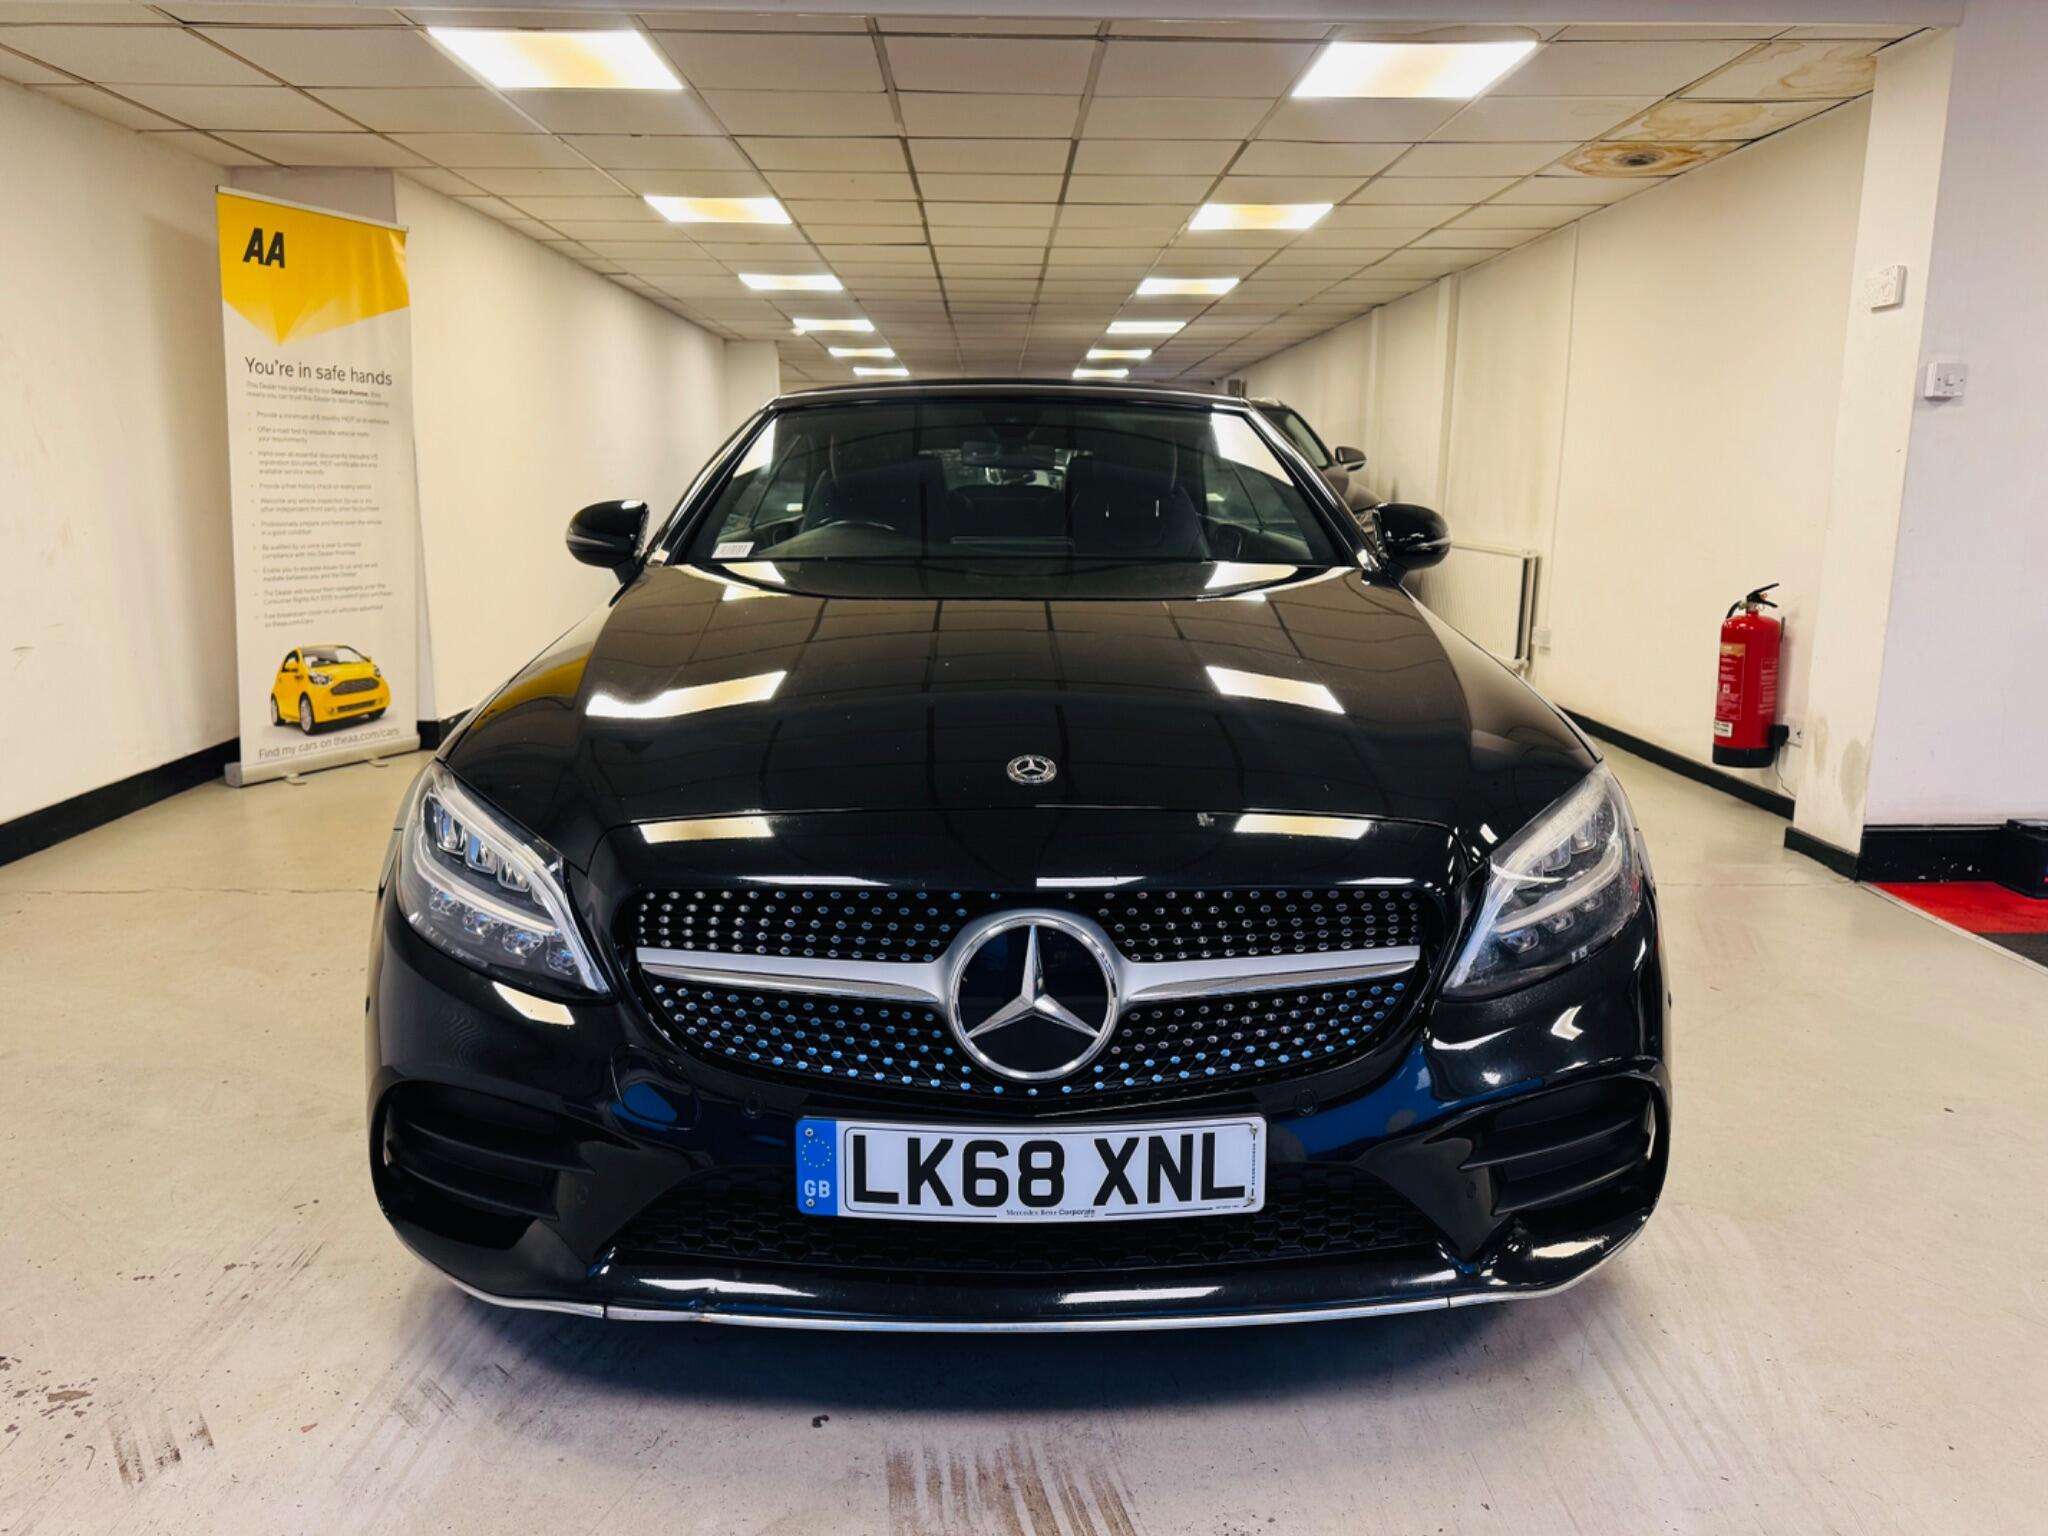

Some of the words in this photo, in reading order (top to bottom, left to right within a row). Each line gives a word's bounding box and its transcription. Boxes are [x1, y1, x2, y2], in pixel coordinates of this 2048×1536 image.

[243, 227, 286, 268] AA
[245, 356, 294, 378] You're
[298, 361, 312, 379] in
[315, 365, 346, 382] safe
[350, 367, 393, 386] hands
[258, 747, 280, 760] Find
[282, 745, 297, 756] my
[298, 742, 318, 753] cars
[320, 739, 332, 749] on
[852, 1133, 1065, 1208] LK68
[1093, 1132, 1246, 1206] XNL
[803, 1178, 832, 1199] GB
